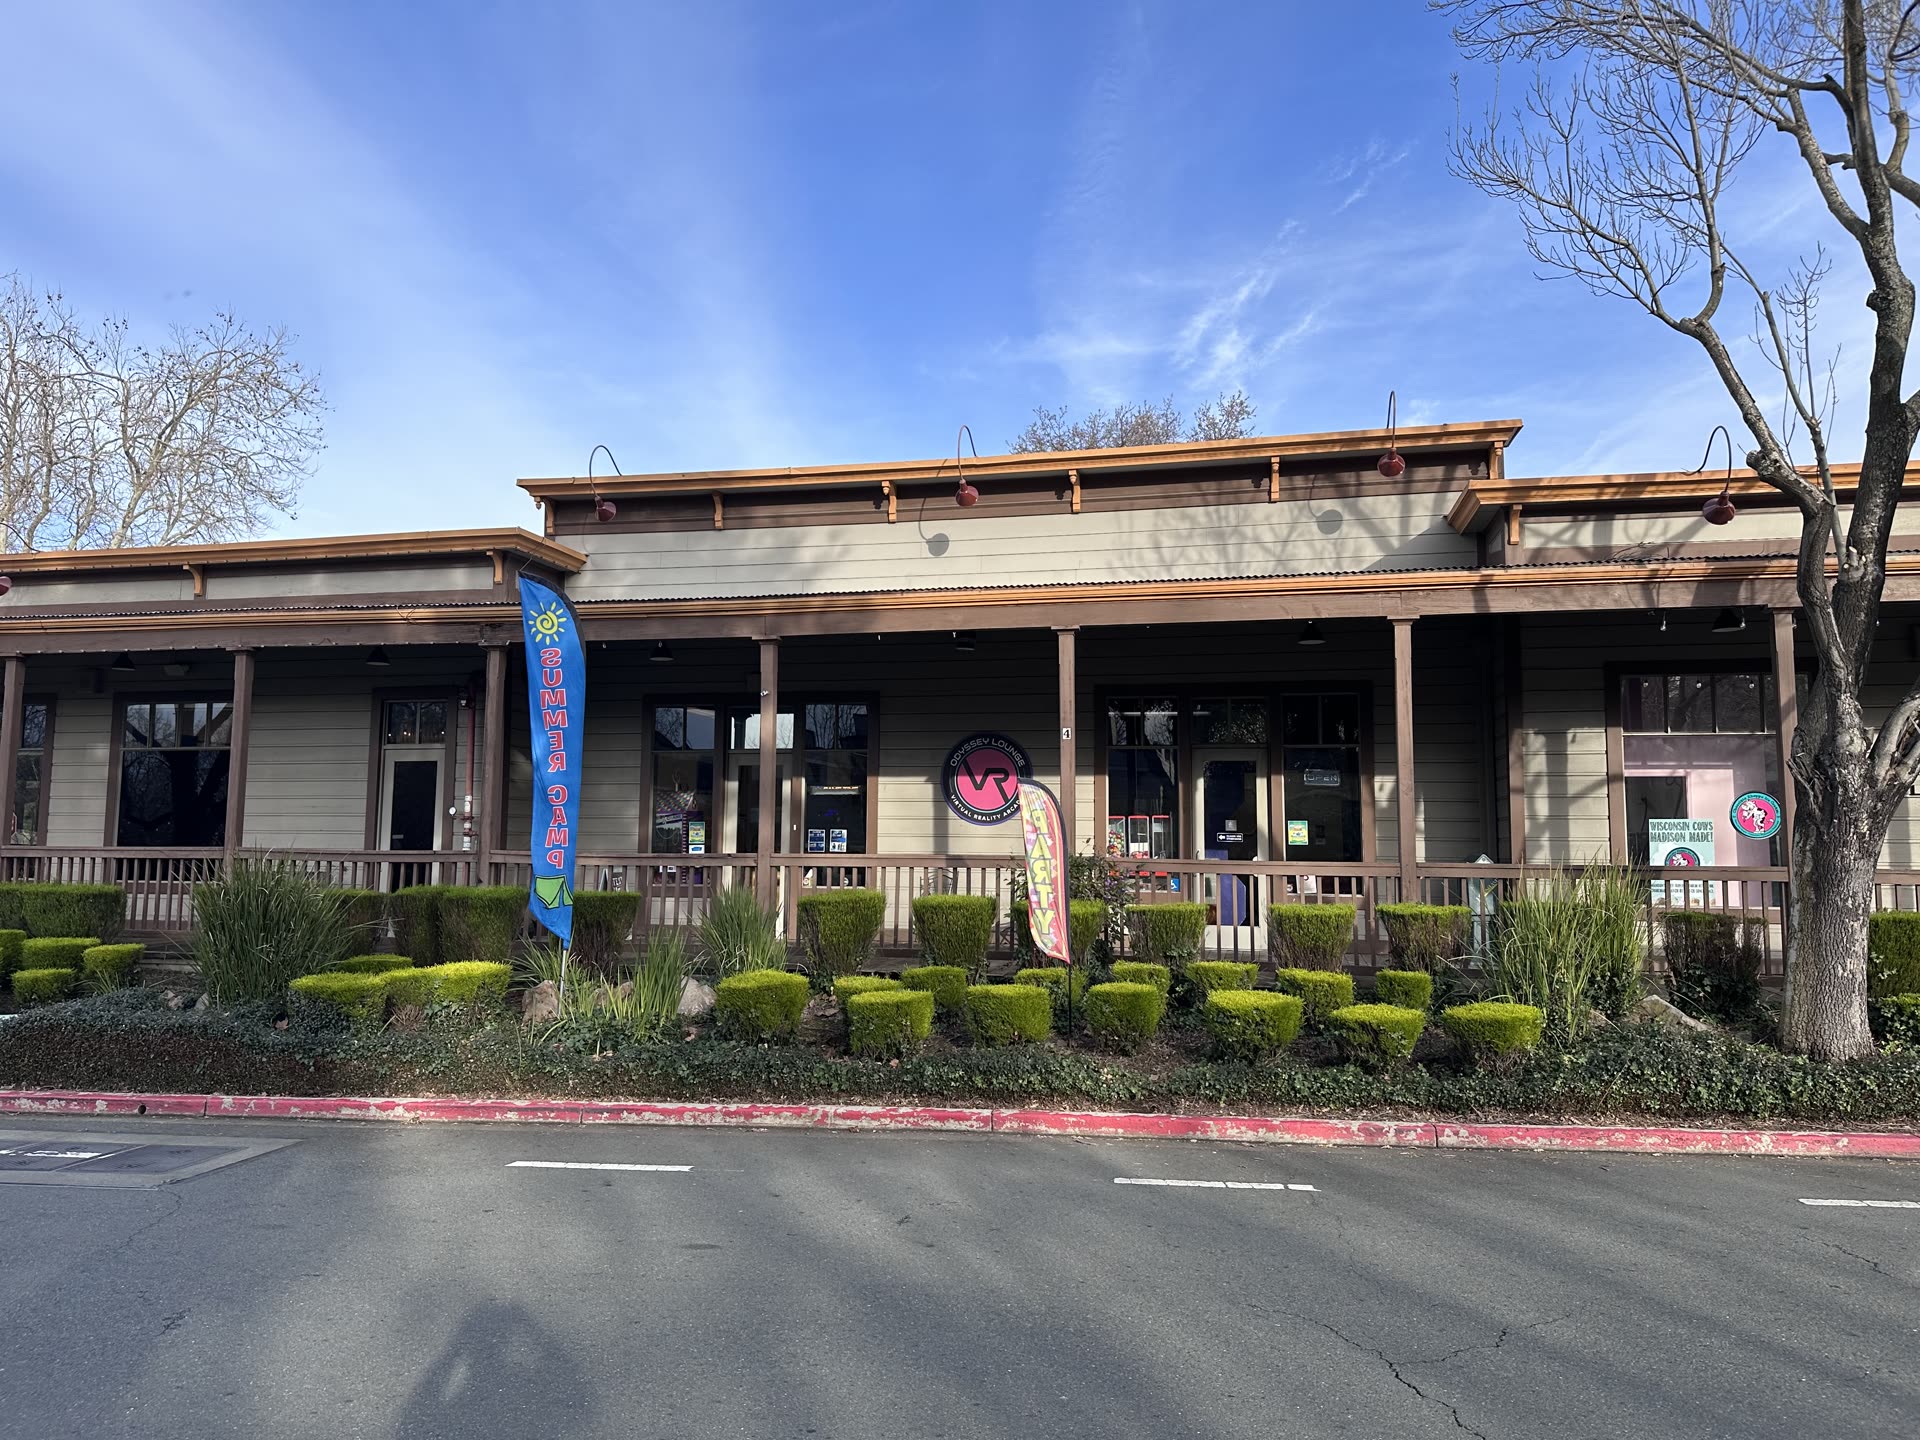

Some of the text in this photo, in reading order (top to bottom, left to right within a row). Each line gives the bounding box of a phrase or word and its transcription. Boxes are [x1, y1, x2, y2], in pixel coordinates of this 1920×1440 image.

[950, 738, 1026, 767] ODYSSEY LOUNGE
[961, 758, 1010, 804] VR
[950, 794, 1021, 821] VIRTUAL REALITY ARCAD
[1650, 821, 1713, 832] WISCONSIN COWS
[1650, 832, 1714, 843] MADISON MADE!
